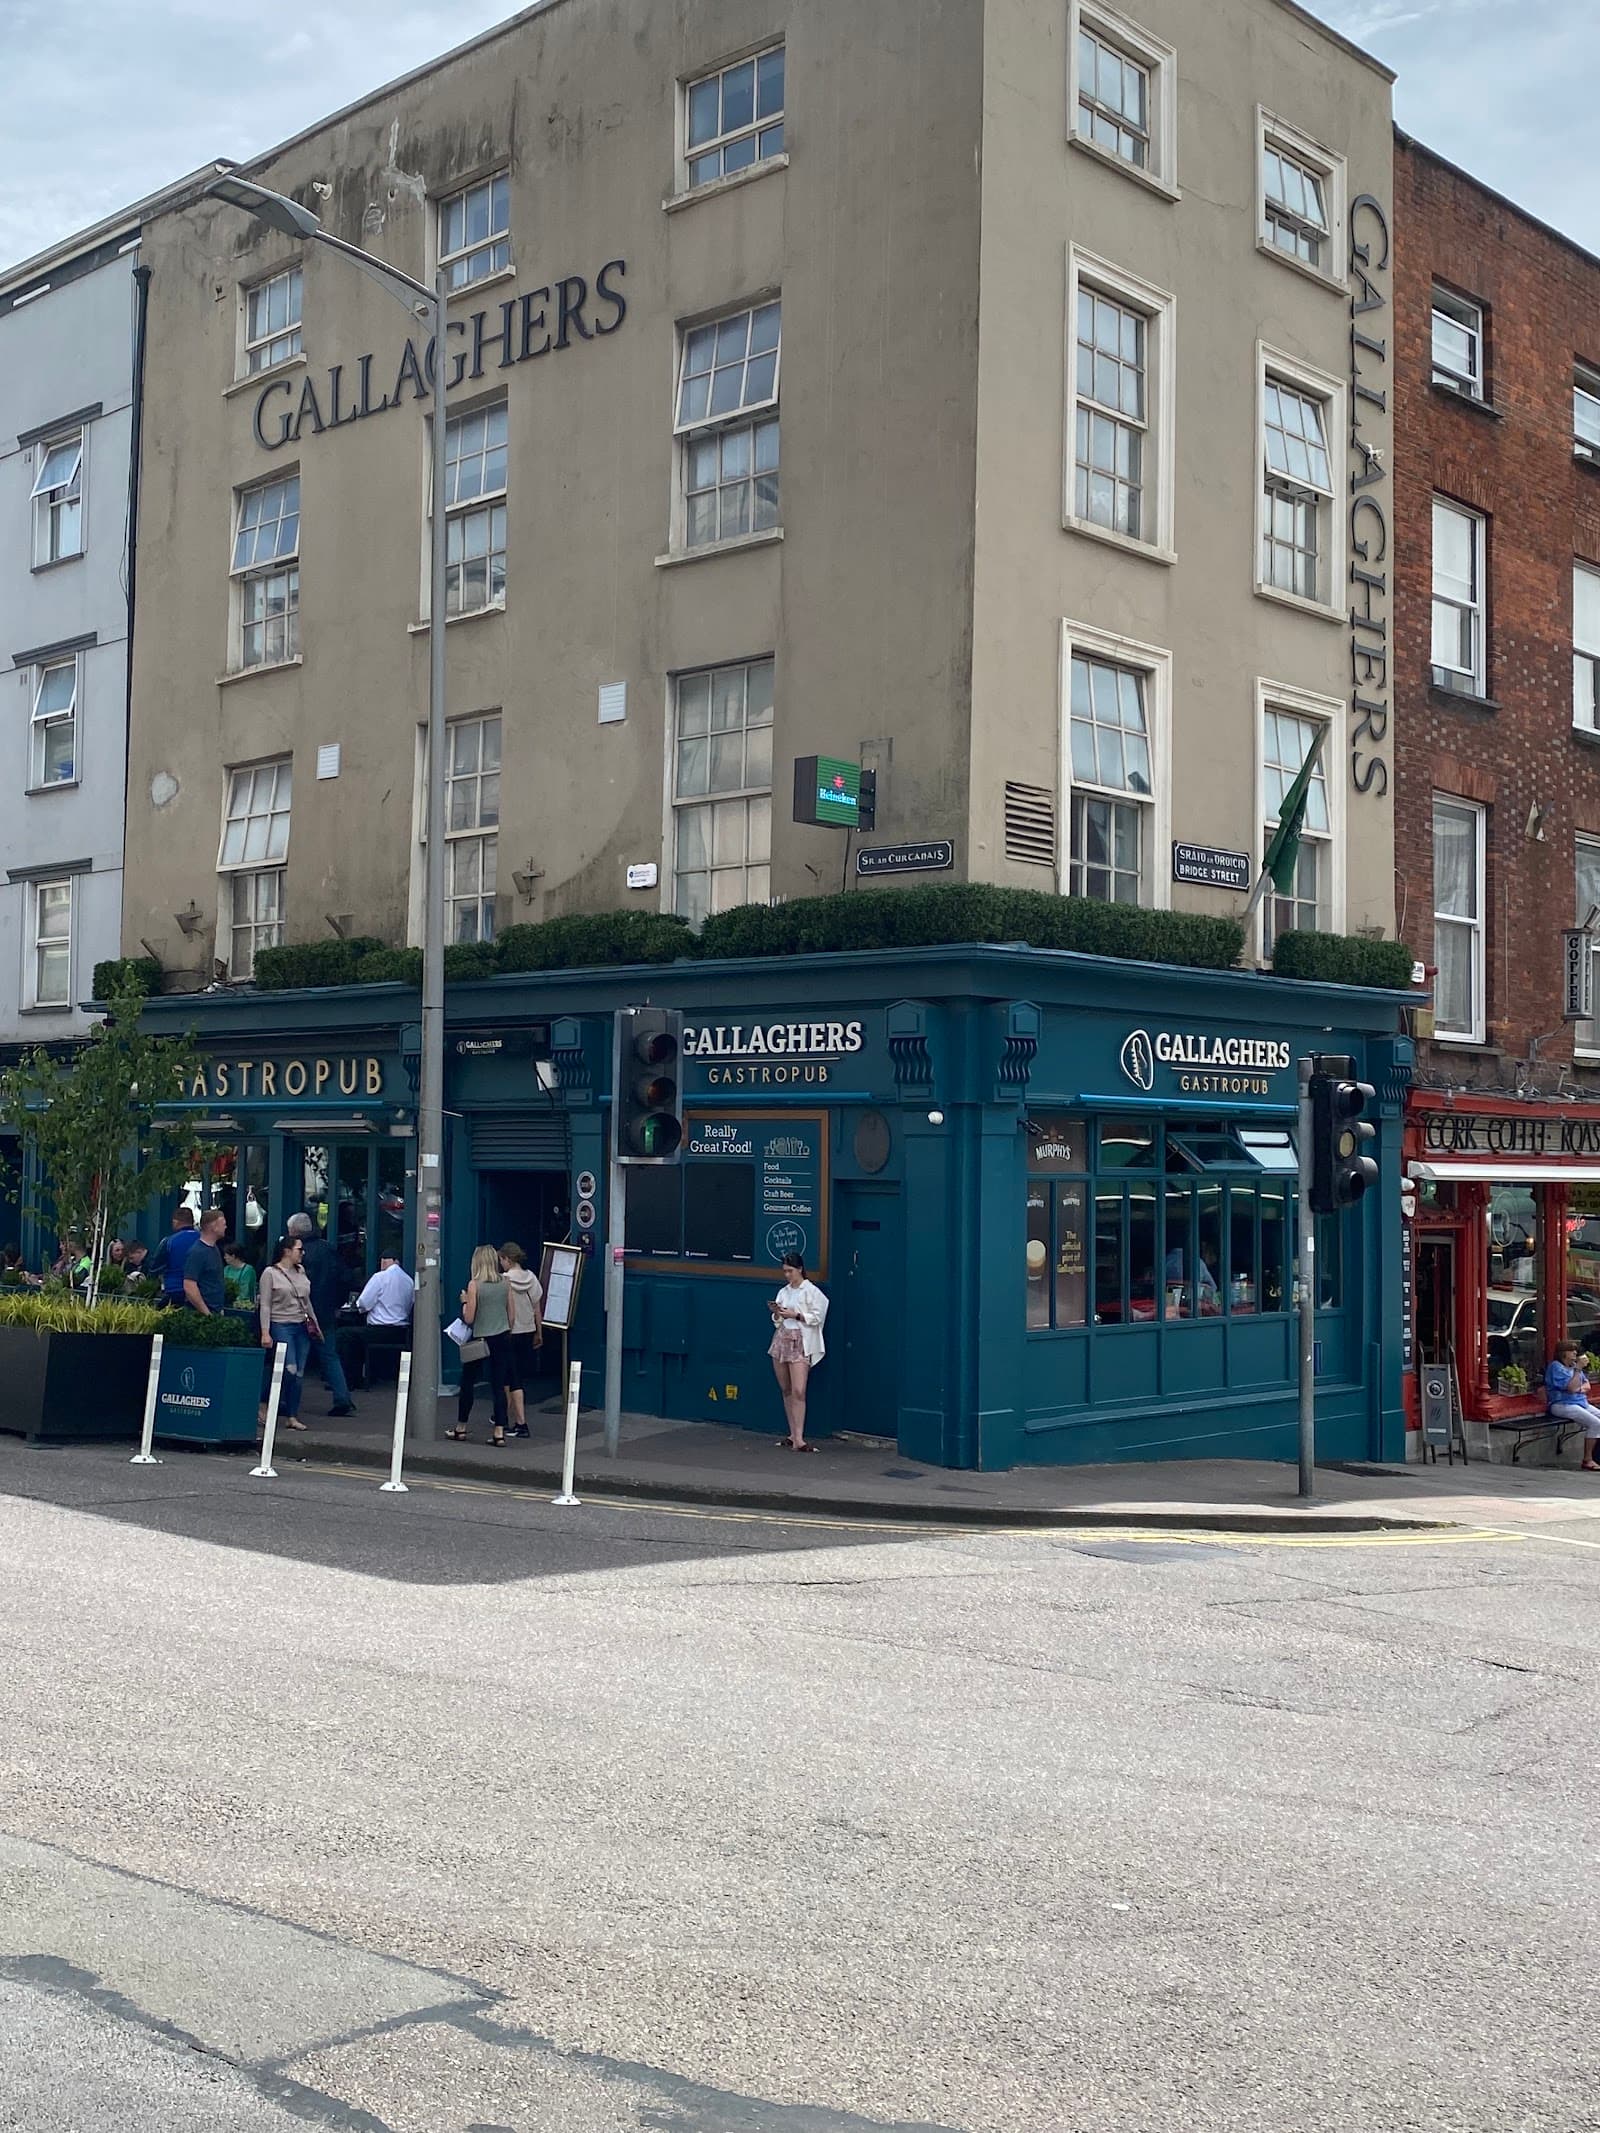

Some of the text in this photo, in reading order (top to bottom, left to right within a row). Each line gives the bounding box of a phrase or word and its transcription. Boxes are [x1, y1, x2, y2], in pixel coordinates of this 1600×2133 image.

[253, 259, 626, 450] GALLAGHERS
[1350, 194, 1389, 796] GALLAGHERS
[1179, 863, 1240, 884] BRIDGE STREET
[683, 1022, 862, 1056] GALLAGHERS
[1156, 1032, 1290, 1069] GALLAGHERS
[708, 1065, 828, 1084] GASTROPUB
[1181, 1075, 1269, 1095] GASTROPUB
[704, 1124, 738, 1141] Really
[1427, 1115, 1477, 1149] CORK
[689, 1140, 753, 1154] Great Food!
[763, 1162, 780, 1171] Food
[161, 1393, 211, 1408] GALLAGHERS
